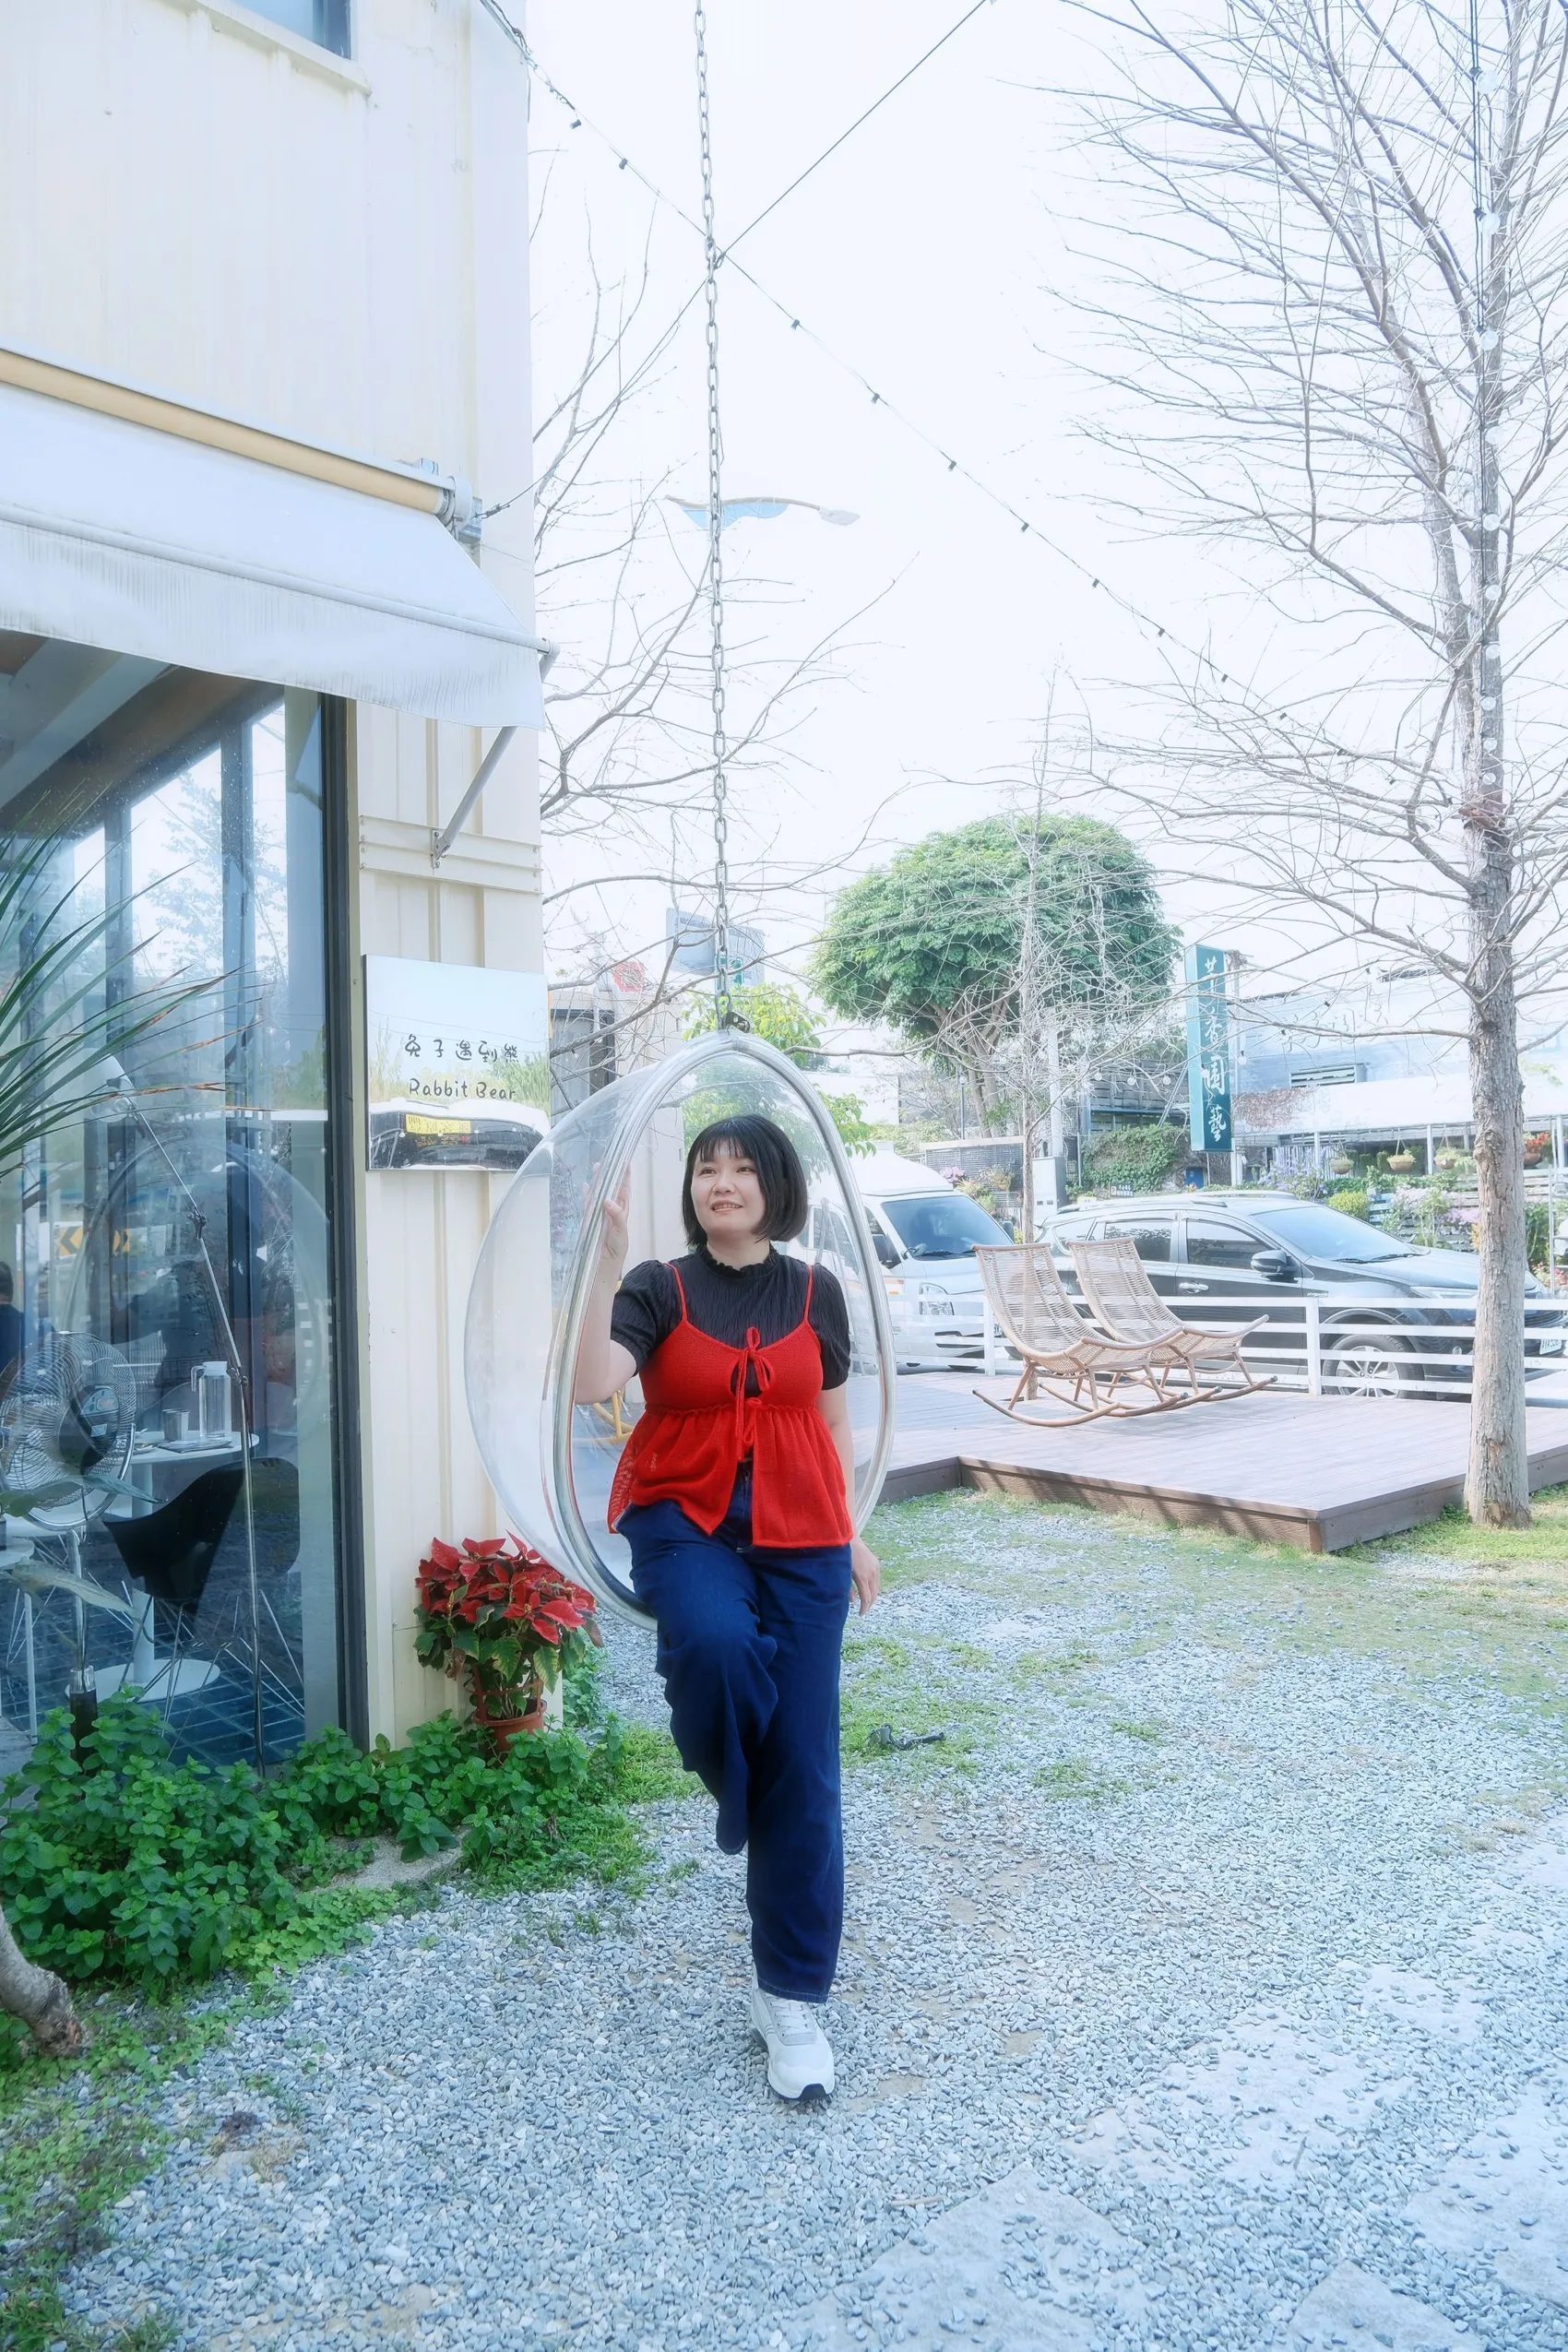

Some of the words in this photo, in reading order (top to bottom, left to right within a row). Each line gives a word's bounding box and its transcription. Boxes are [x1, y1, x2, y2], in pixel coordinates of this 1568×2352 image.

[404, 1033, 519, 1063] 兔子遇到熊
[409, 1077, 469, 1098] Rabbit
[476, 1081, 517, 1099] Bear
